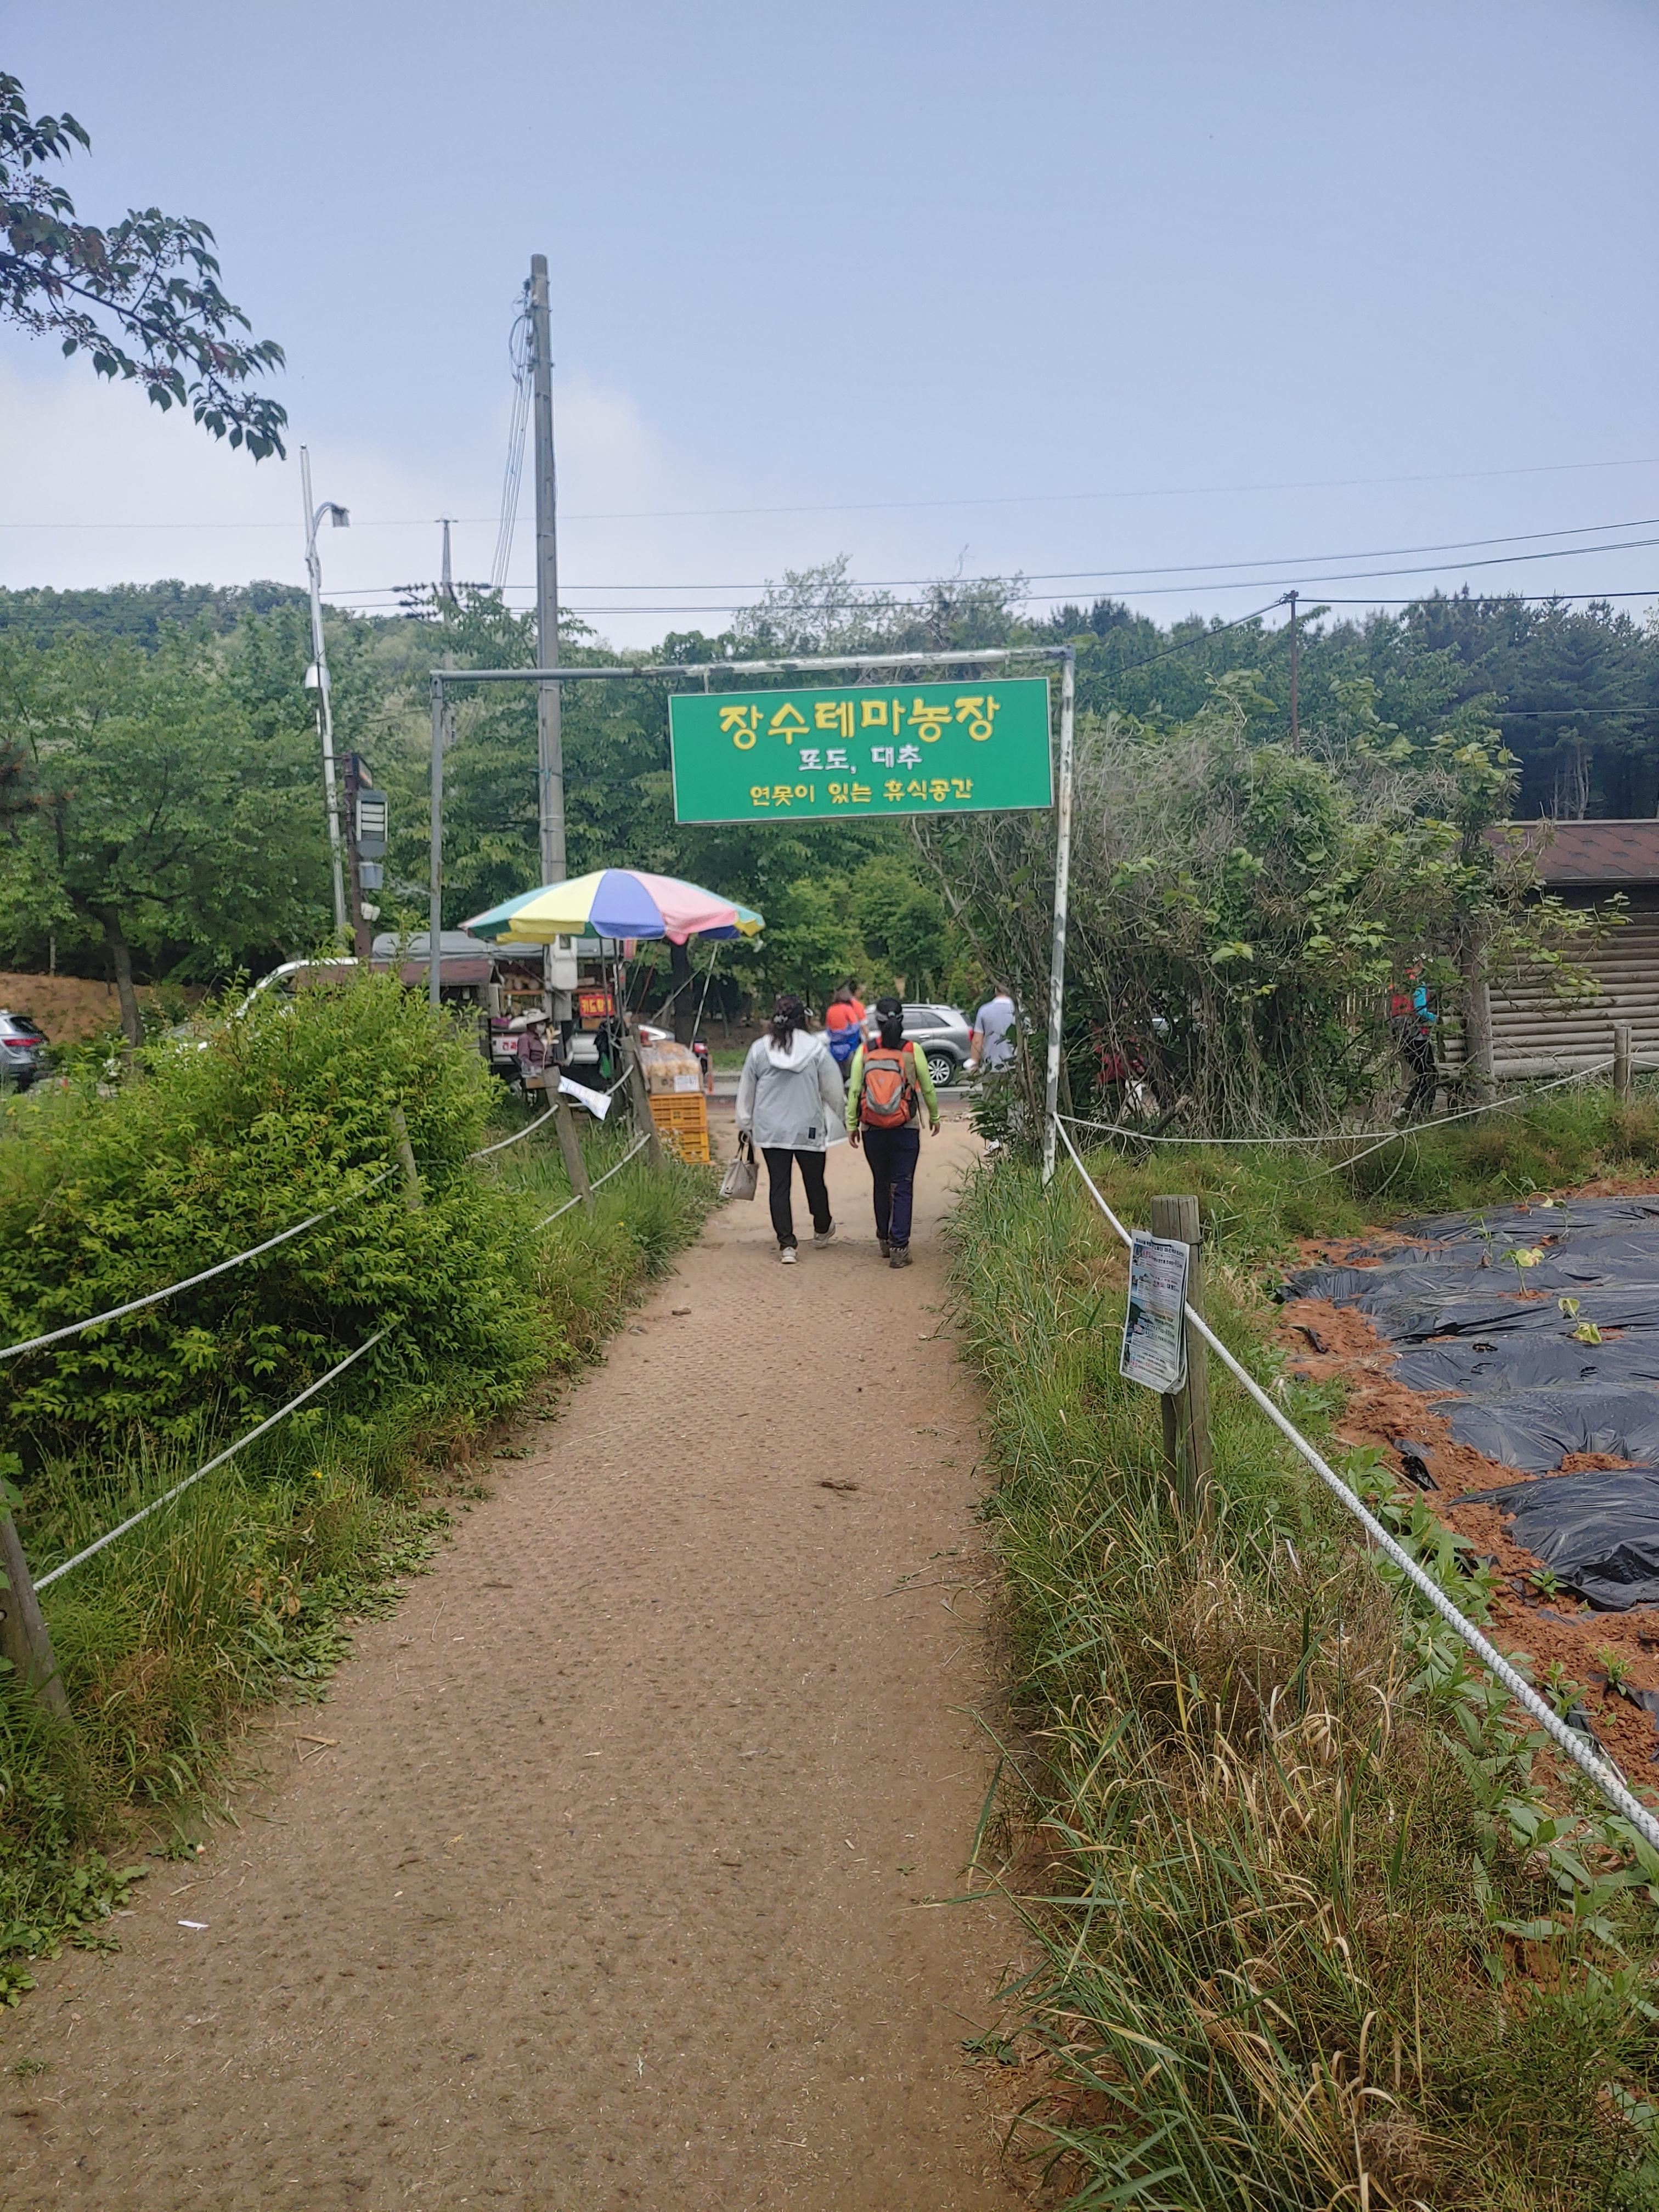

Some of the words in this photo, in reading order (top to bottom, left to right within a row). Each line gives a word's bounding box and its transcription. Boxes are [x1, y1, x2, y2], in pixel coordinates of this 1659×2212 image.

[719, 696, 1001, 750] 장수테마농장
[798, 748, 857, 774] 포도,
[870, 743, 923, 770] 대추
[750, 785, 815, 806] 연못이
[828, 782, 872, 804] 있는
[883, 778, 974, 802] 휴식공간
